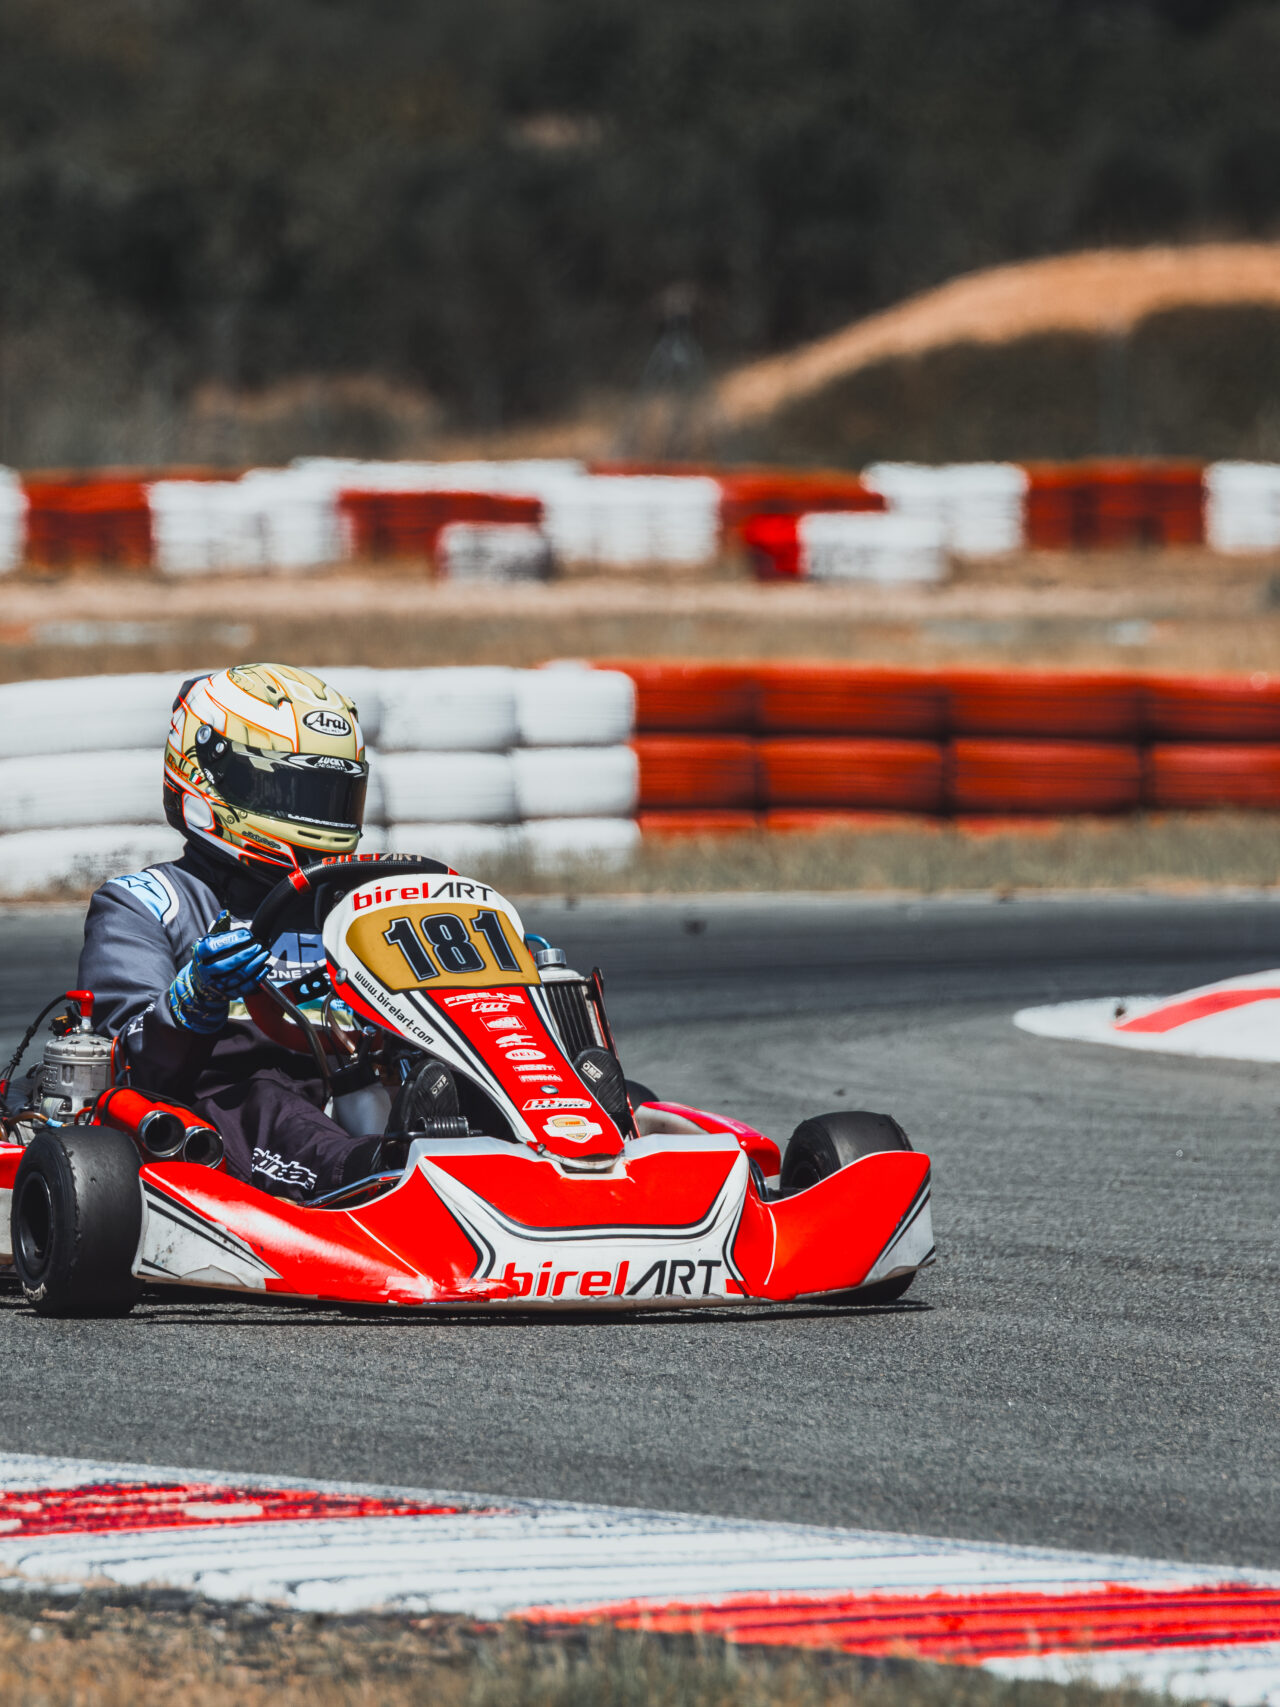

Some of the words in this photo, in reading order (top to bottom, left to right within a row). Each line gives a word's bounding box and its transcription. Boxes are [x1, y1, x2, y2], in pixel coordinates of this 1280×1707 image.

[306, 712, 348, 731] Arai
[317, 756, 346, 768] LUCKY
[352, 881, 494, 911] birelART
[382, 909, 523, 982] 181
[353, 970, 435, 1045] www.birelart.com
[582, 1062, 602, 1079] OMP
[501, 1259, 722, 1297] birelART
